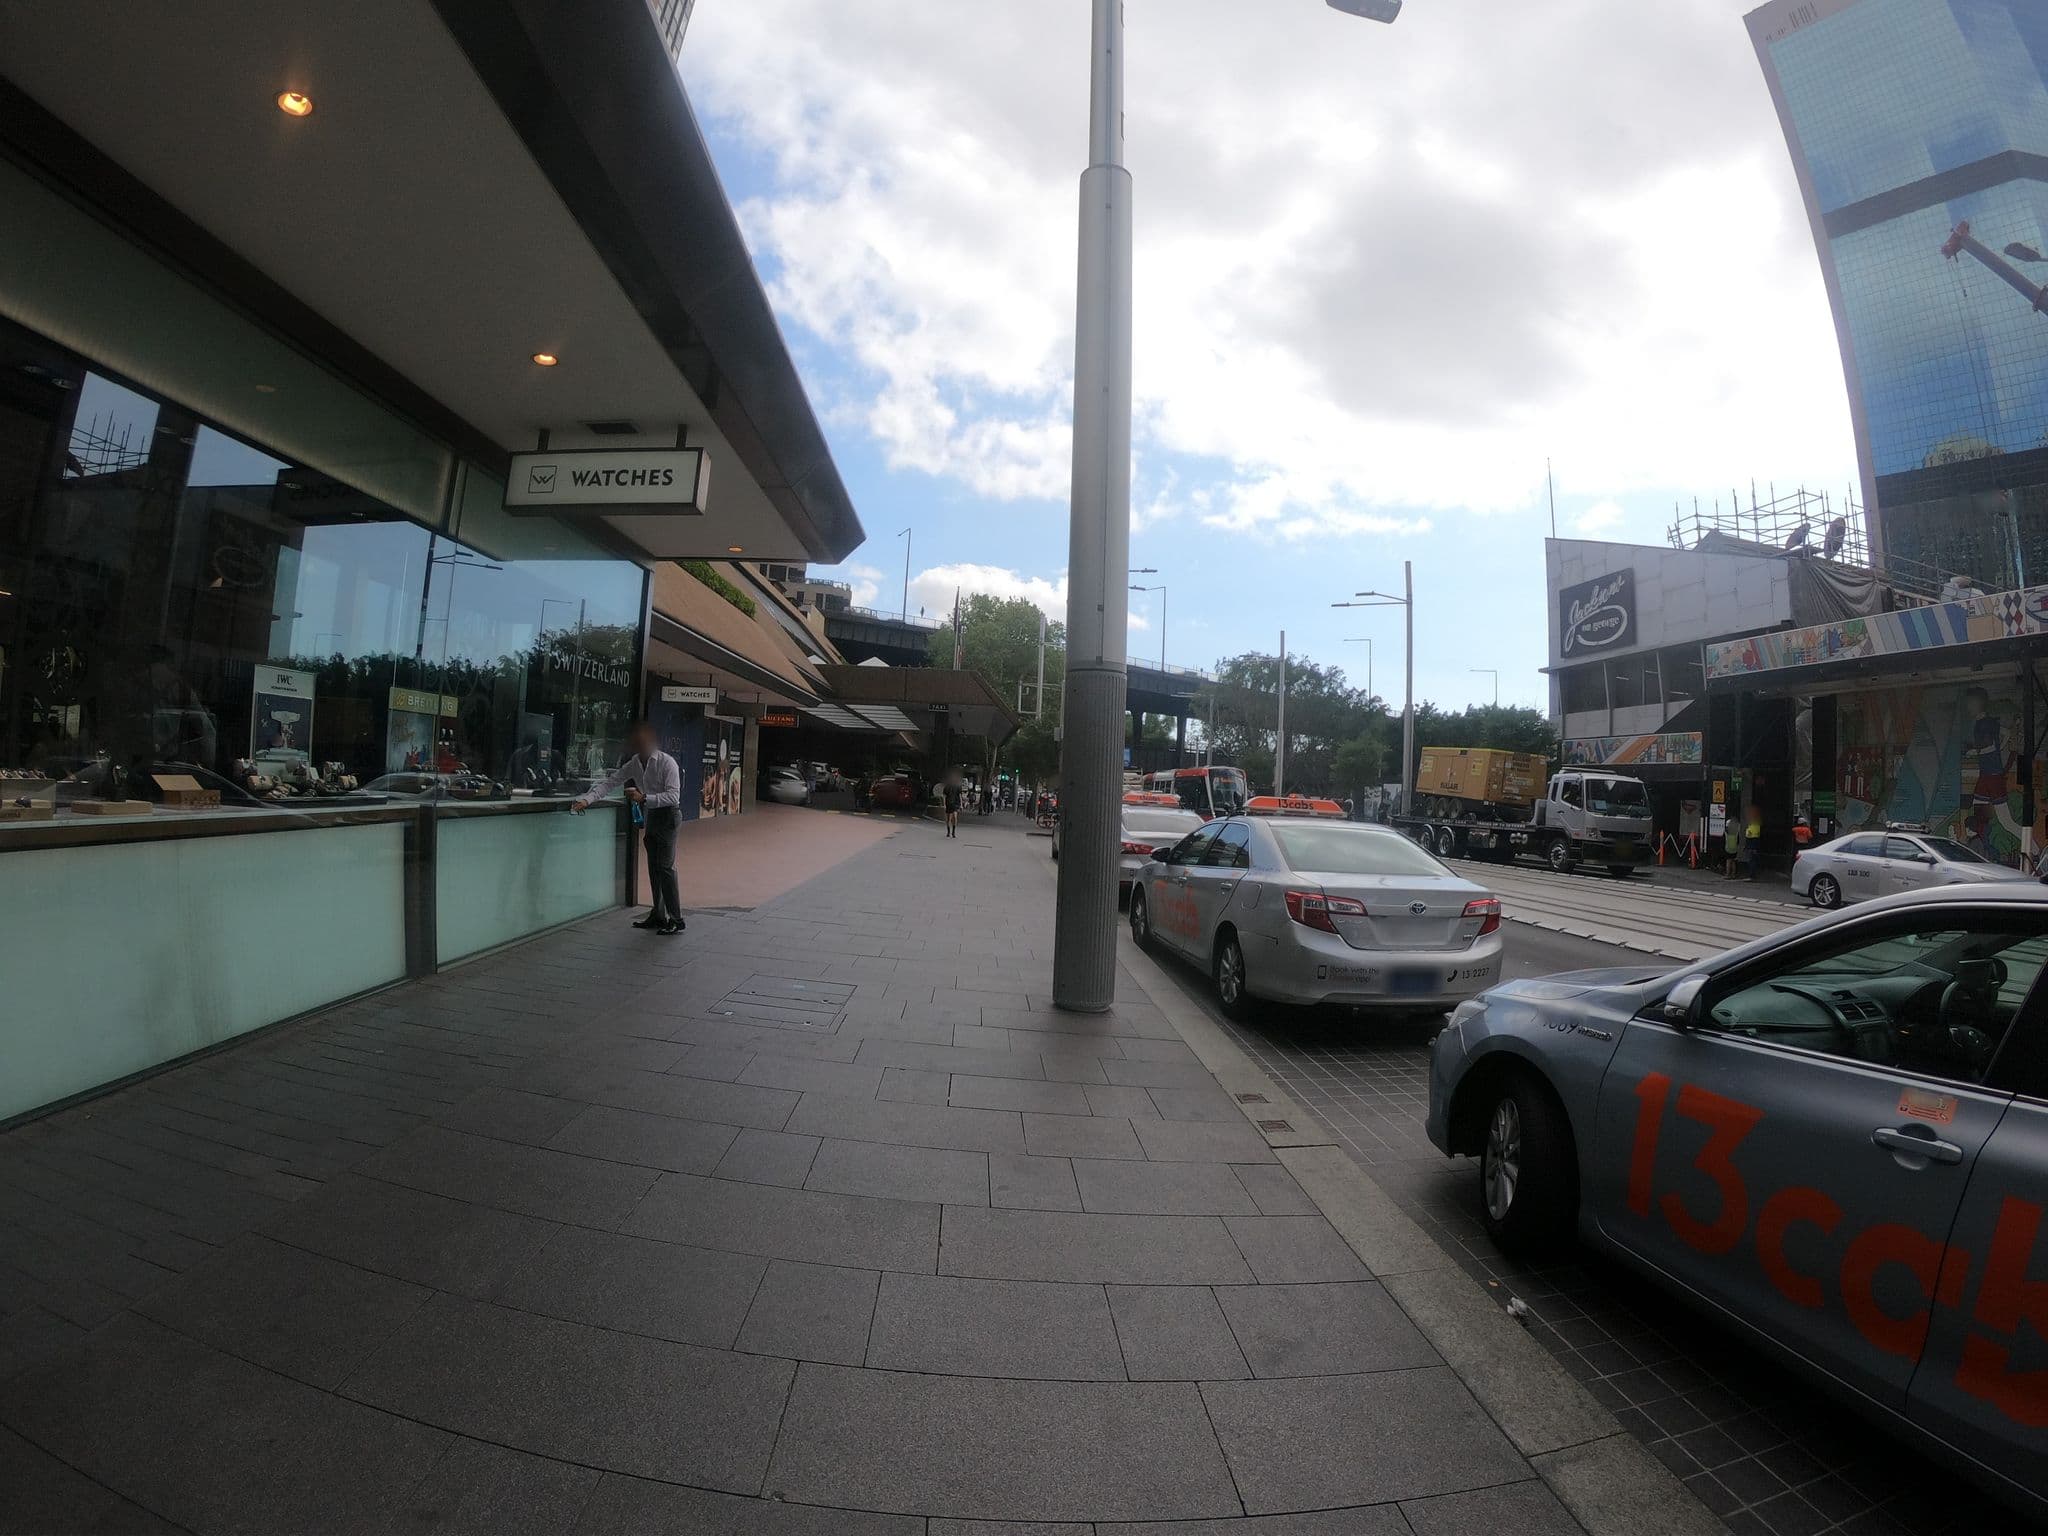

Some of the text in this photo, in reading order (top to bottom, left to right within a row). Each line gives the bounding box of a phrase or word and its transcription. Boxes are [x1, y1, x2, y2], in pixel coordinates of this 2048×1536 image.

[571, 469, 673, 487] WATCHES
[553, 650, 630, 688] SWITZERLAND
[277, 673, 294, 685] IWC
[680, 691, 711, 699] WATCHES
[407, 695, 454, 711] BREITLNG
[1277, 798, 1314, 811] 13cabs
[1461, 967, 1490, 980] 13 2227
